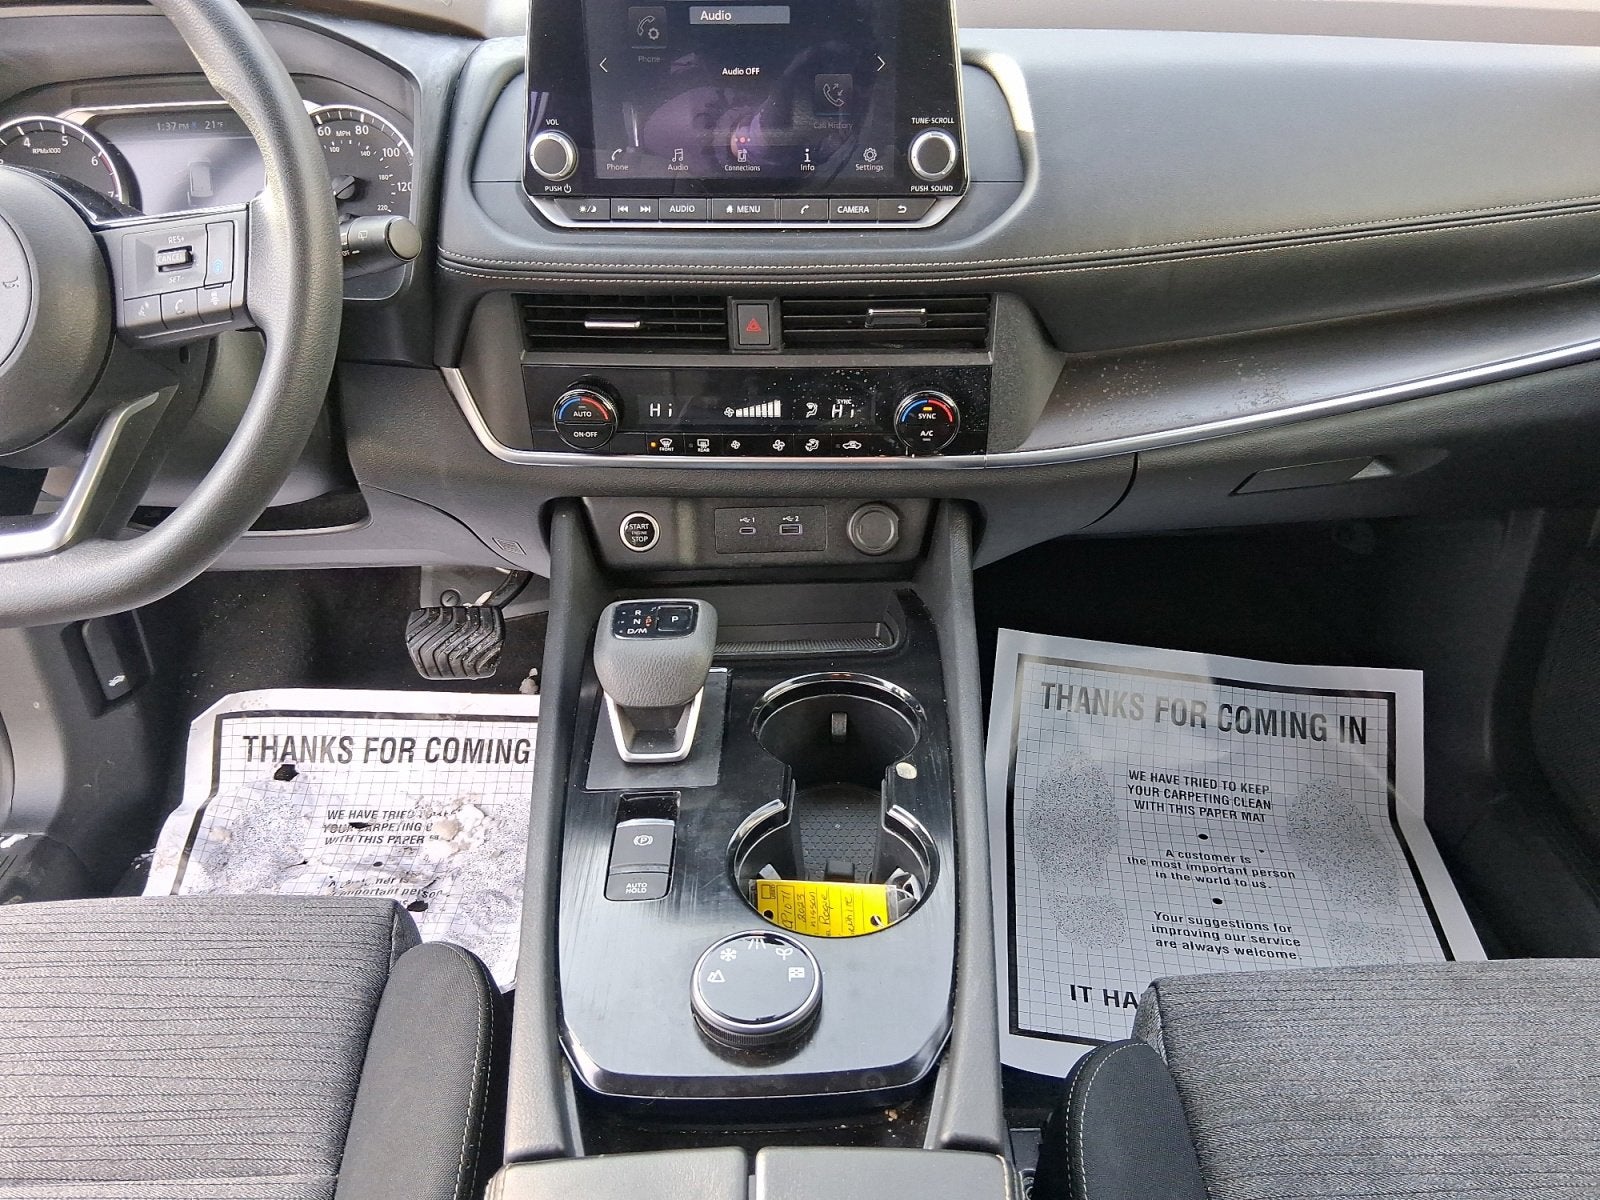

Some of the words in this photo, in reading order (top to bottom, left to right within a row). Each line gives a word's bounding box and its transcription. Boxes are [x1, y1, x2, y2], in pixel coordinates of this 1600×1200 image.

[700, 10, 732, 21] Audio
[722, 67, 744, 76] Audio
[745, 67, 760, 76] OFF
[157, 121, 177, 131] 1:37
[178, 123, 190, 131] PM
[545, 118, 559, 126] VOL
[317, 125, 331, 137] 60
[355, 125, 369, 136] 80
[23, 137, 31, 147] 4
[61, 135, 69, 146] 5
[382, 147, 400, 158] 100
[91, 155, 99, 166] 6
[606, 163, 629, 171] Phone
[667, 163, 689, 171] Audio
[724, 164, 761, 172] Connections
[800, 163, 815, 171] Info
[855, 163, 884, 173] Settings
[397, 181, 412, 192] 120
[107, 190, 115, 199] 7
[669, 203, 695, 213] AUDIO
[736, 205, 761, 213] MENU
[837, 205, 870, 214] CAMERA
[573, 410, 592, 418] AUTO
[649, 402, 673, 418] Hi
[831, 403, 855, 419] Hi
[631, 535, 649, 543] STOP
[671, 615, 679, 623] P
[626, 627, 648, 635] D/M
[1041, 682, 1144, 721] THANKS
[1155, 696, 1207, 729] FOR
[1217, 703, 1327, 742] COMING
[1339, 715, 1366, 745] IN
[243, 735, 353, 764] THANKS
[363, 736, 416, 764] FOR
[425, 736, 530, 765] COMING
[1129, 770, 1147, 781] WE
[1150, 773, 1180, 785] HAVE
[1183, 776, 1217, 790] TRIED
[1223, 780, 1237, 792] TO
[1240, 782, 1270, 796] KEEP
[1127, 784, 1160, 798] YOUR
[1163, 788, 1230, 806] CARPETING
[1233, 796, 1272, 810] CLEAN
[327, 809, 345, 820] WE
[348, 809, 379, 820] HAVE
[1134, 799, 1165, 812] WITH
[1168, 803, 1195, 816] THIS
[1199, 806, 1238, 820] PAPER
[1242, 811, 1266, 823] MAT
[358, 822, 423, 832] ARPETING
[324, 834, 354, 846] WITH
[358, 834, 385, 845] THIS
[387, 834, 425, 845] PAPER
[1165, 849, 1175, 858] A
[1177, 851, 1236, 864] customer
[1240, 855, 1252, 865] is
[1127, 856, 1147, 866] the
[1151, 859, 1182, 870] most
[1186, 863, 1248, 877] important
[1252, 868, 1296, 880] person
[1155, 870, 1167, 880] in
[1171, 872, 1191, 882] the
[1195, 875, 1231, 887] world
[1235, 878, 1248, 888] to
[1251, 881, 1272, 890] us.
[1153, 910, 1184, 924] Your
[1187, 916, 1270, 932] suggestions
[1273, 922, 1293, 934] for
[1151, 923, 1220, 941] improving
[1224, 932, 1246, 942] our
[1250, 934, 1301, 947] service
[1155, 938, 1177, 949] are
[1182, 940, 1230, 956] always
[1234, 947, 1302, 960] welcome.
[1070, 984, 1093, 1003] IT
